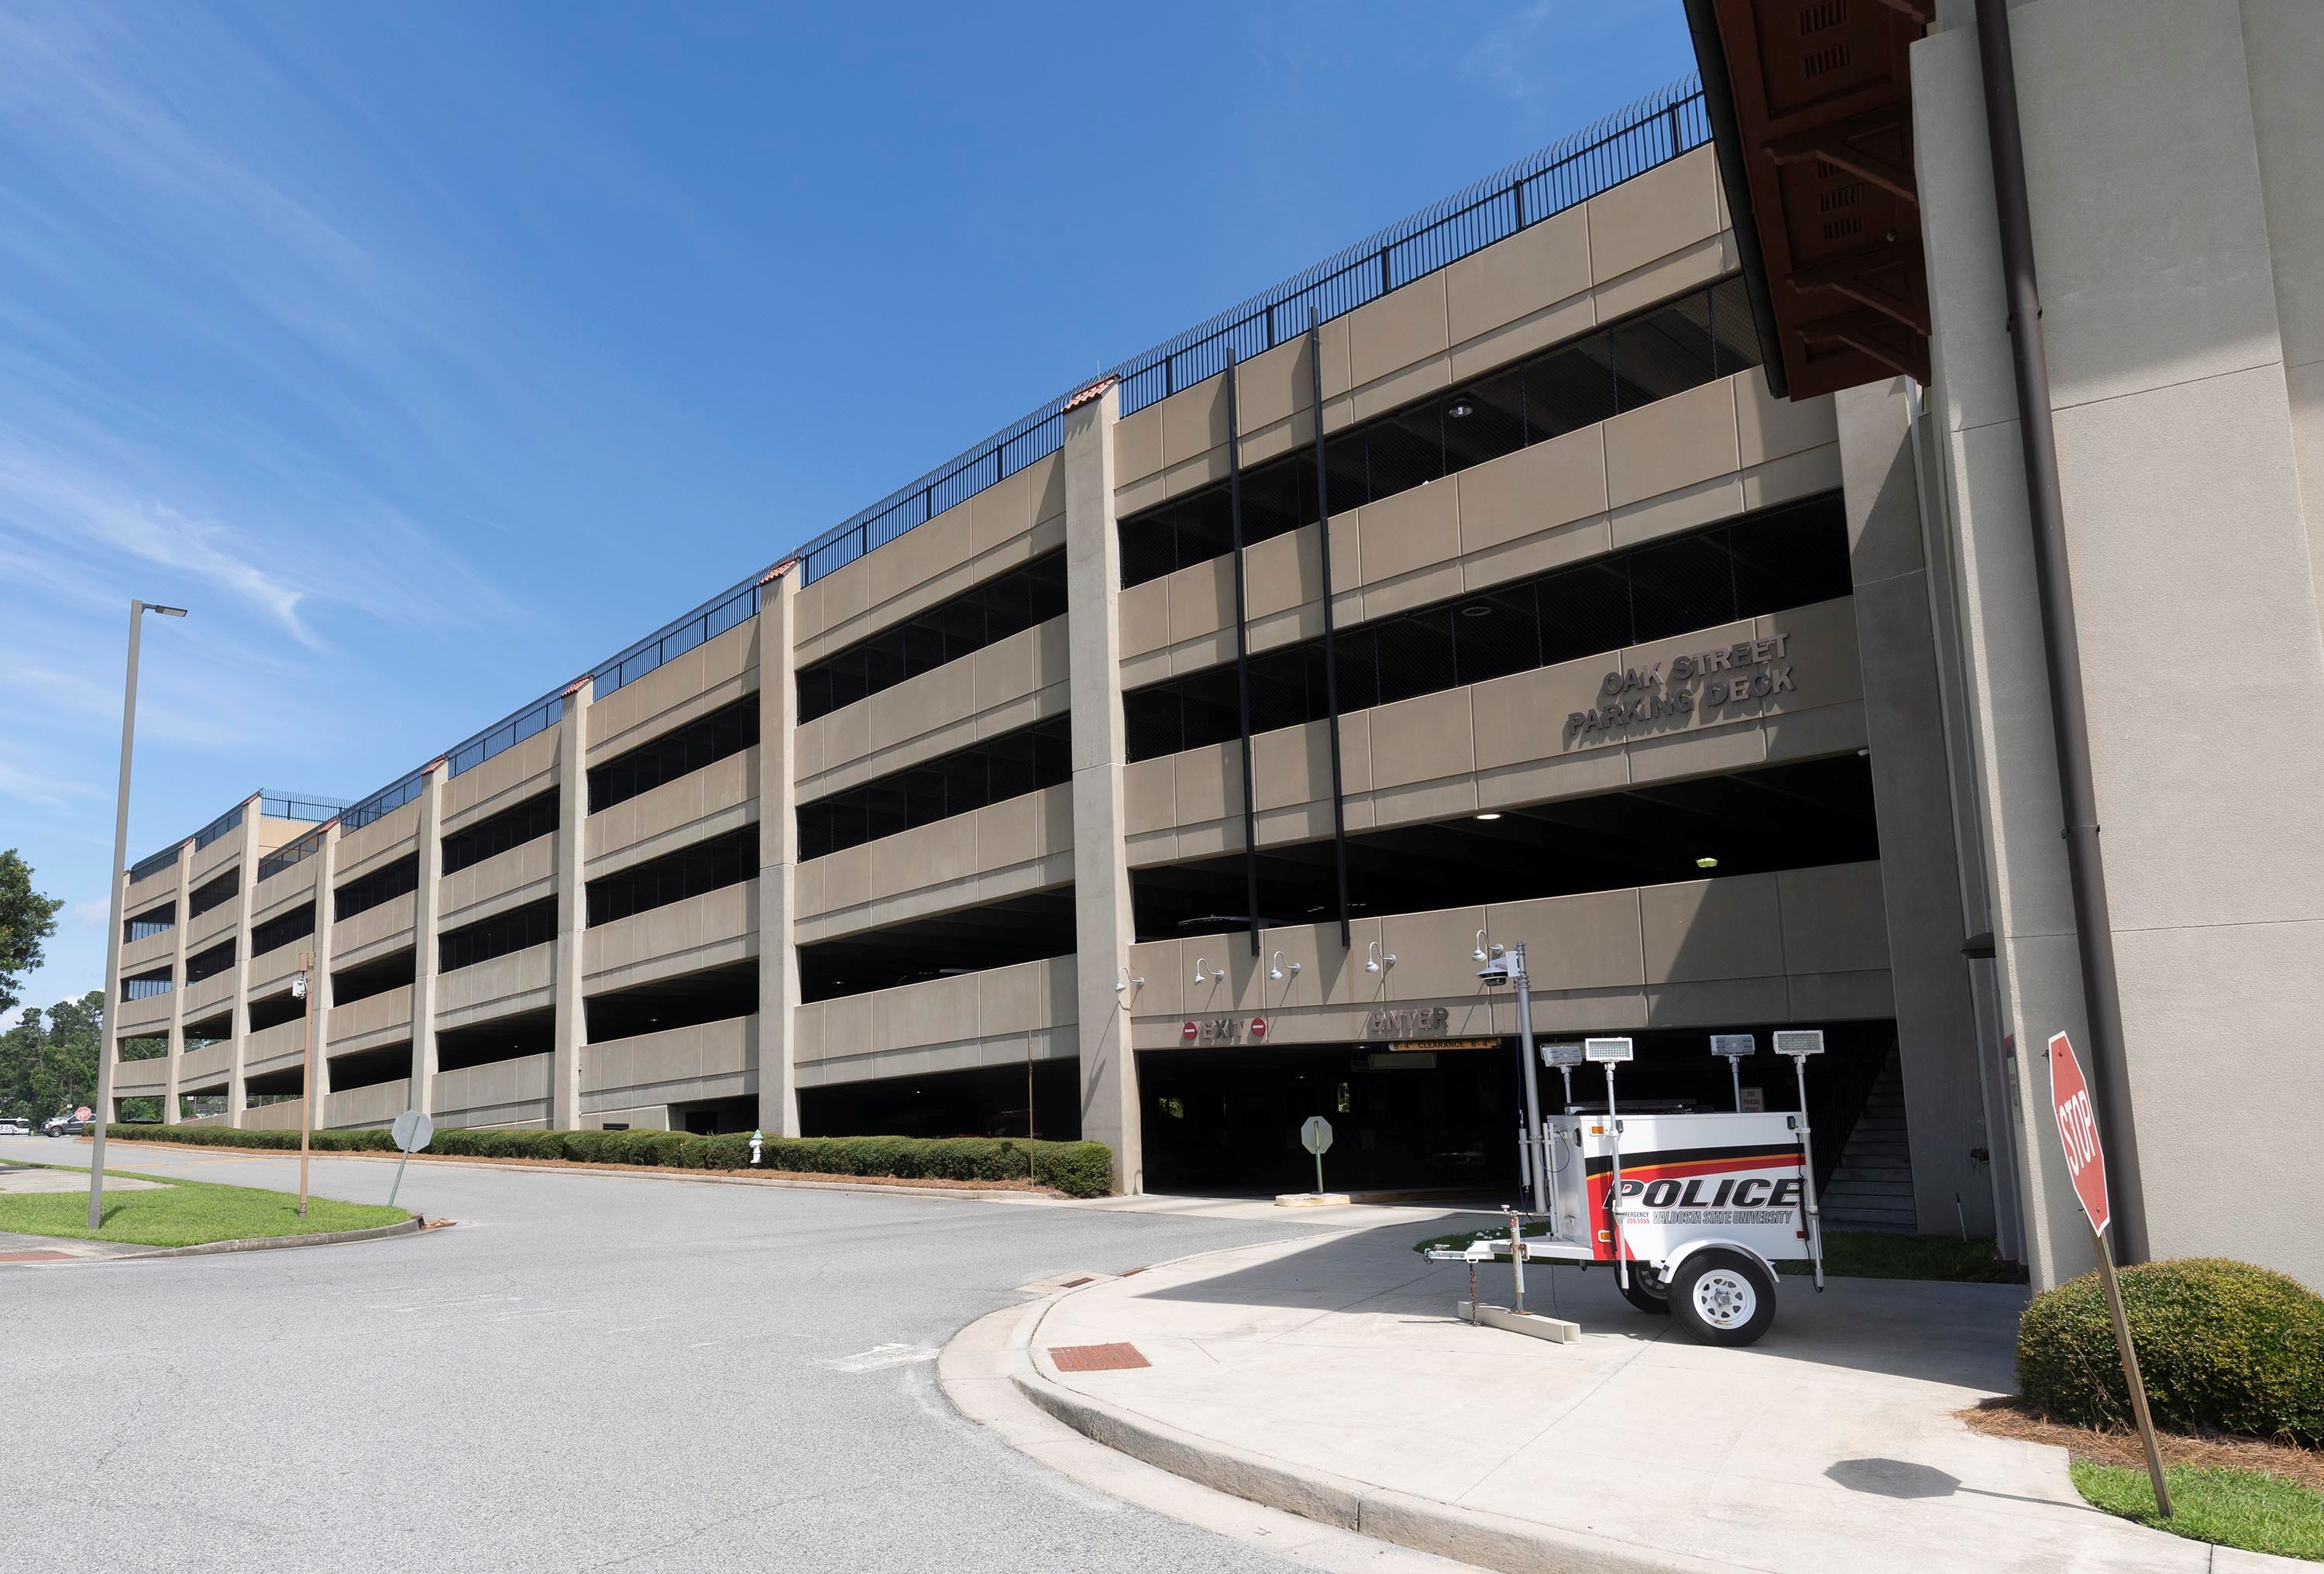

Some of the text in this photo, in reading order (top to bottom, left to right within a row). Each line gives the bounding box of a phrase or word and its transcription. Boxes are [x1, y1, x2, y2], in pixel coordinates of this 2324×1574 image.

[1601, 632, 1789, 696] OAK STREET
[1567, 666, 1796, 735] PARKING DECK
[1202, 1018, 1246, 1040] EXIT
[1370, 1006, 1450, 1033] ENTER
[1418, 1040, 1466, 1049] CLEARANCE
[2059, 1090, 2095, 1177] STOP
[1602, 1178, 1808, 1210] POLICE
[1653, 1211, 1702, 1224] VALDOSTA
[1703, 1211, 1732, 1224] STATE
[1733, 1210, 1793, 1224] UNIVERSITY
